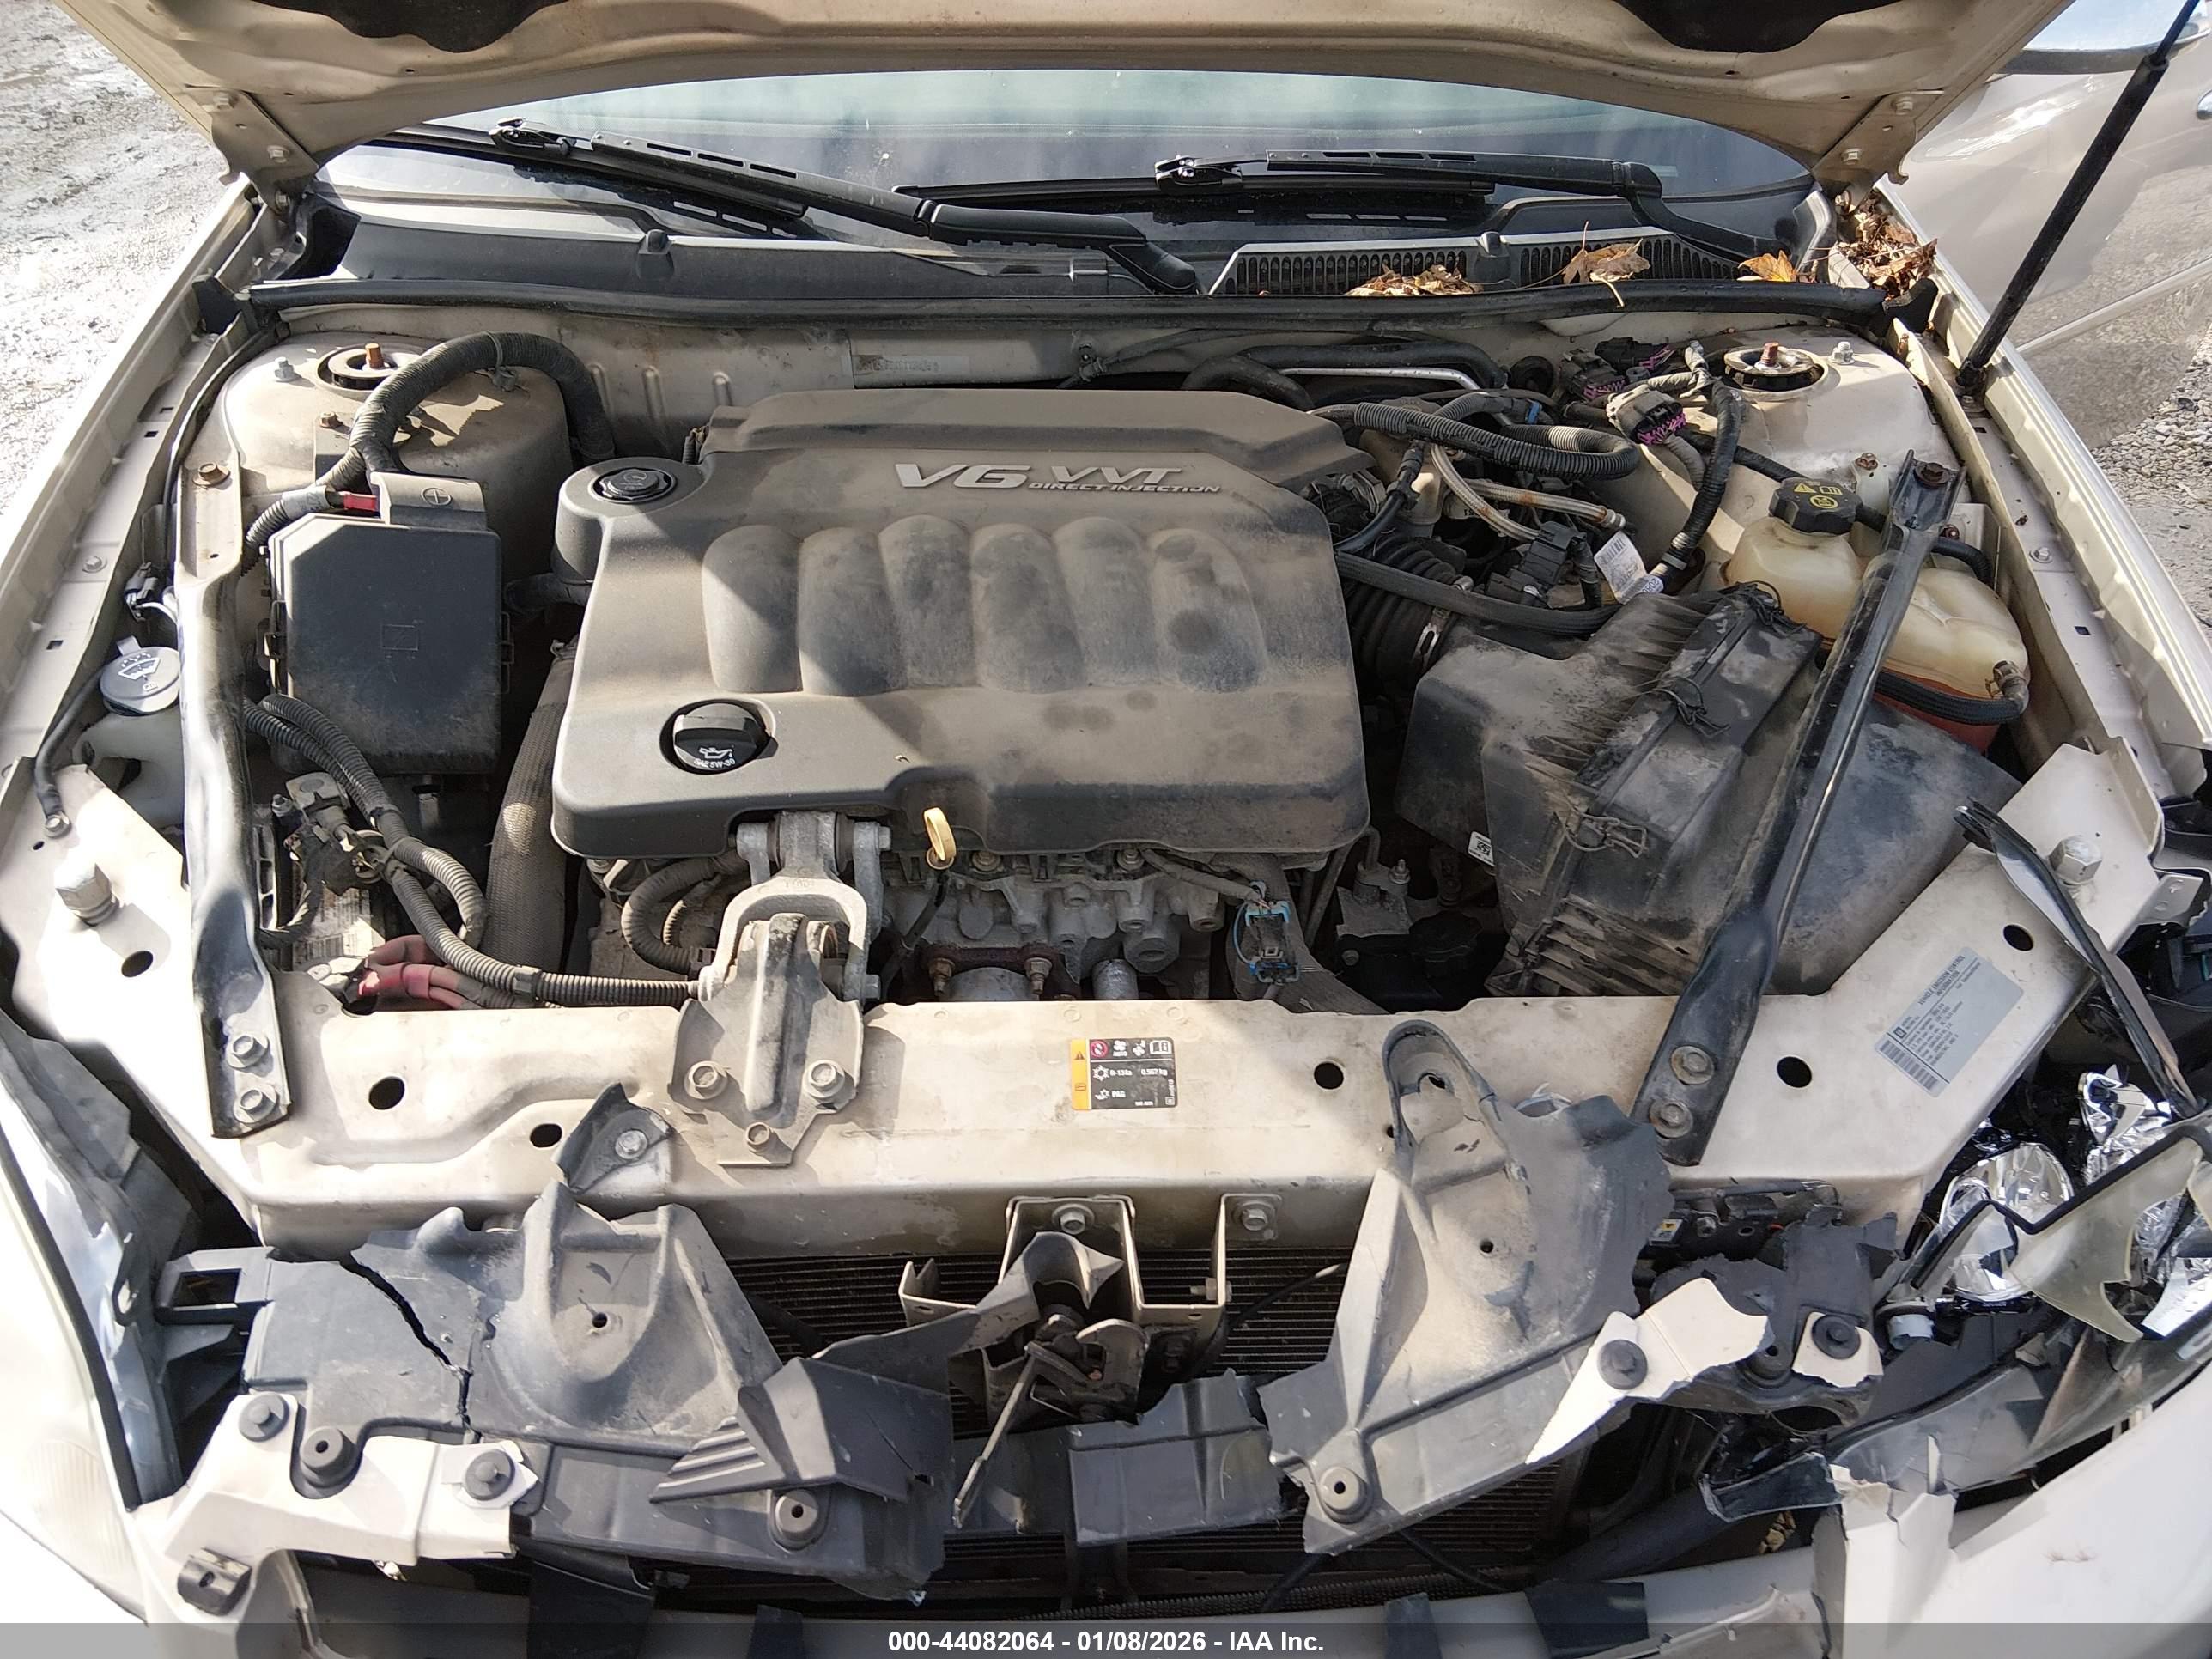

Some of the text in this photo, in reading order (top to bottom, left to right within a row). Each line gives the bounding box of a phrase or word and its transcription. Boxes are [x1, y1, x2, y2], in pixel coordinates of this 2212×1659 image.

[895, 463, 1182, 489] V6 VVT
[1028, 483, 1221, 494] DIRECT INJECTION
[693, 757, 736, 769] SAE 5W-30
